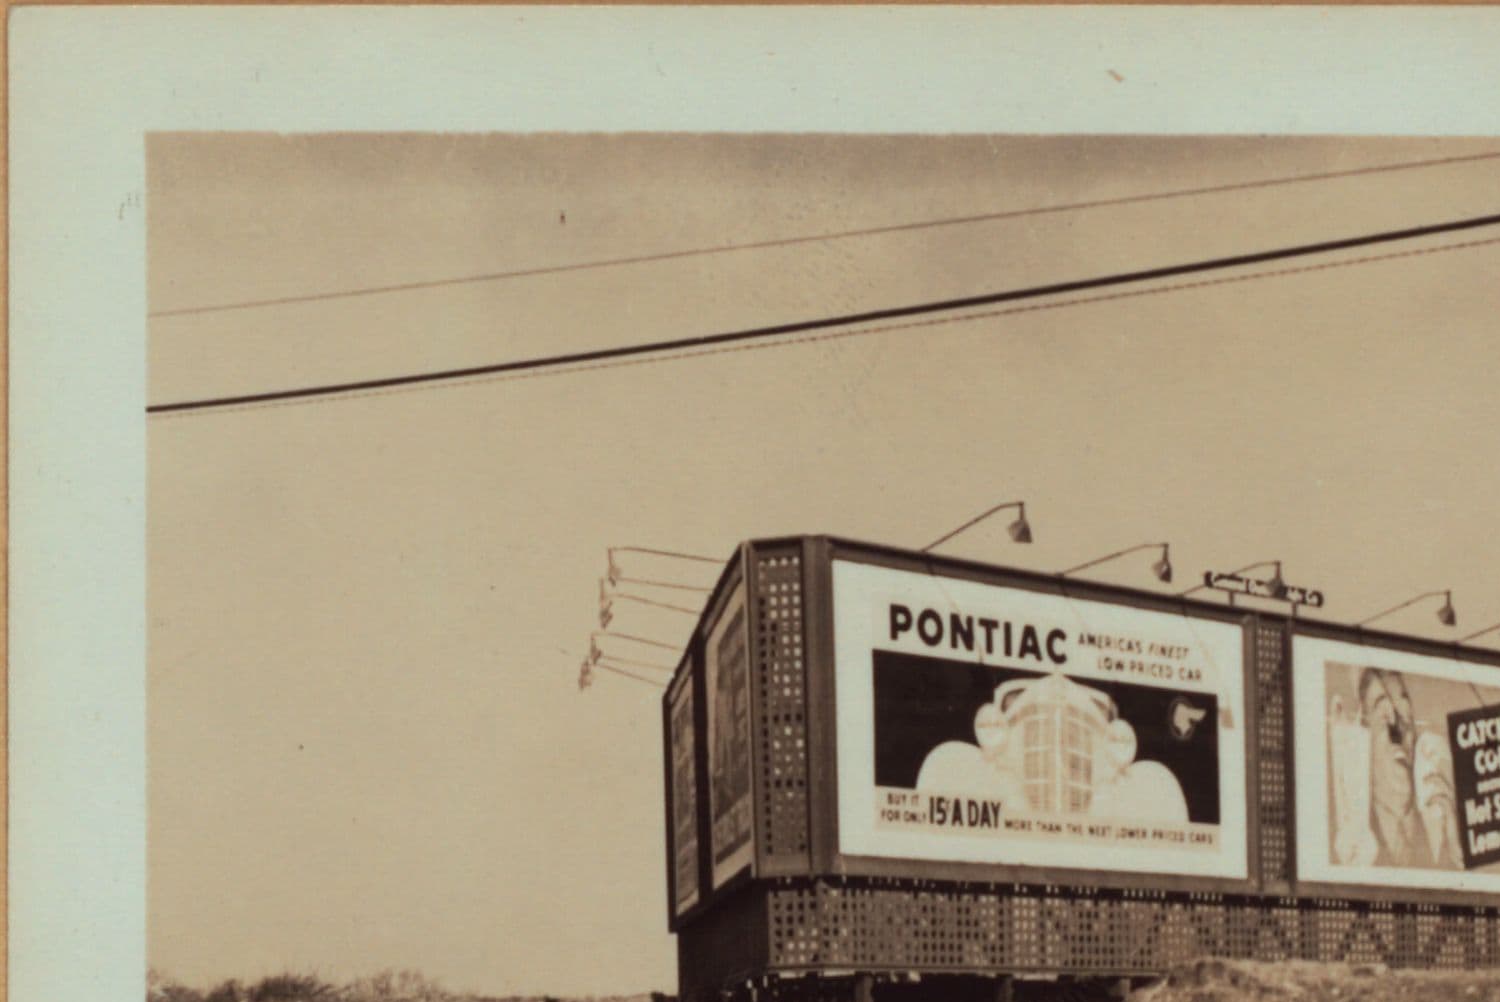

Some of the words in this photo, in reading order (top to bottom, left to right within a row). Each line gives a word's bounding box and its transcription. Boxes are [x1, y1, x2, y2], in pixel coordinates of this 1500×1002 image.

[890, 603, 1067, 664] PONTIAC
[1177, 666, 1202, 681] CAR
[881, 809, 901, 822] FOR
[951, 798, 964, 827] A
[967, 800, 1001, 829] DAY
